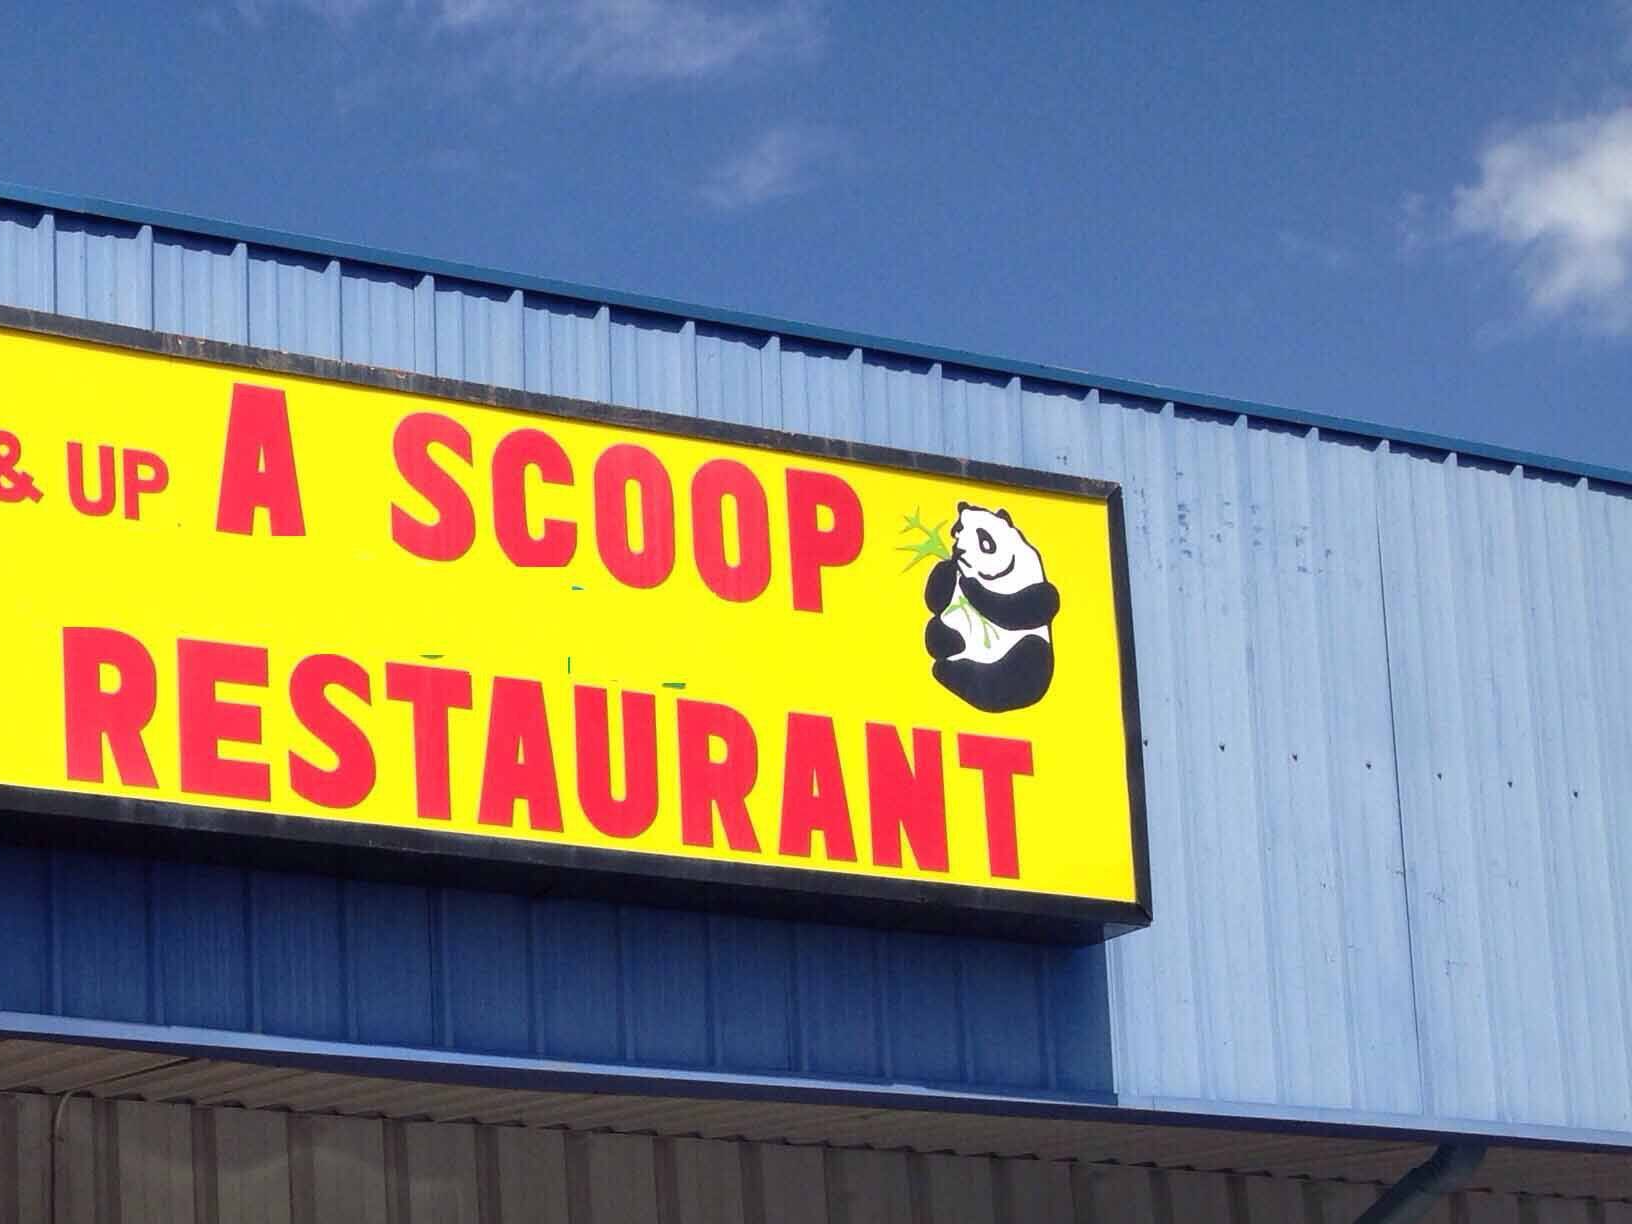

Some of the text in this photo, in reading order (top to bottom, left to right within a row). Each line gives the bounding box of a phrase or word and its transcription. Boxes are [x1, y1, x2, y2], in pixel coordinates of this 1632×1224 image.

[70, 444, 167, 517] UP
[219, 385, 304, 537] A
[394, 414, 862, 610] SCOOP
[65, 629, 1032, 876] RESTAURANT
